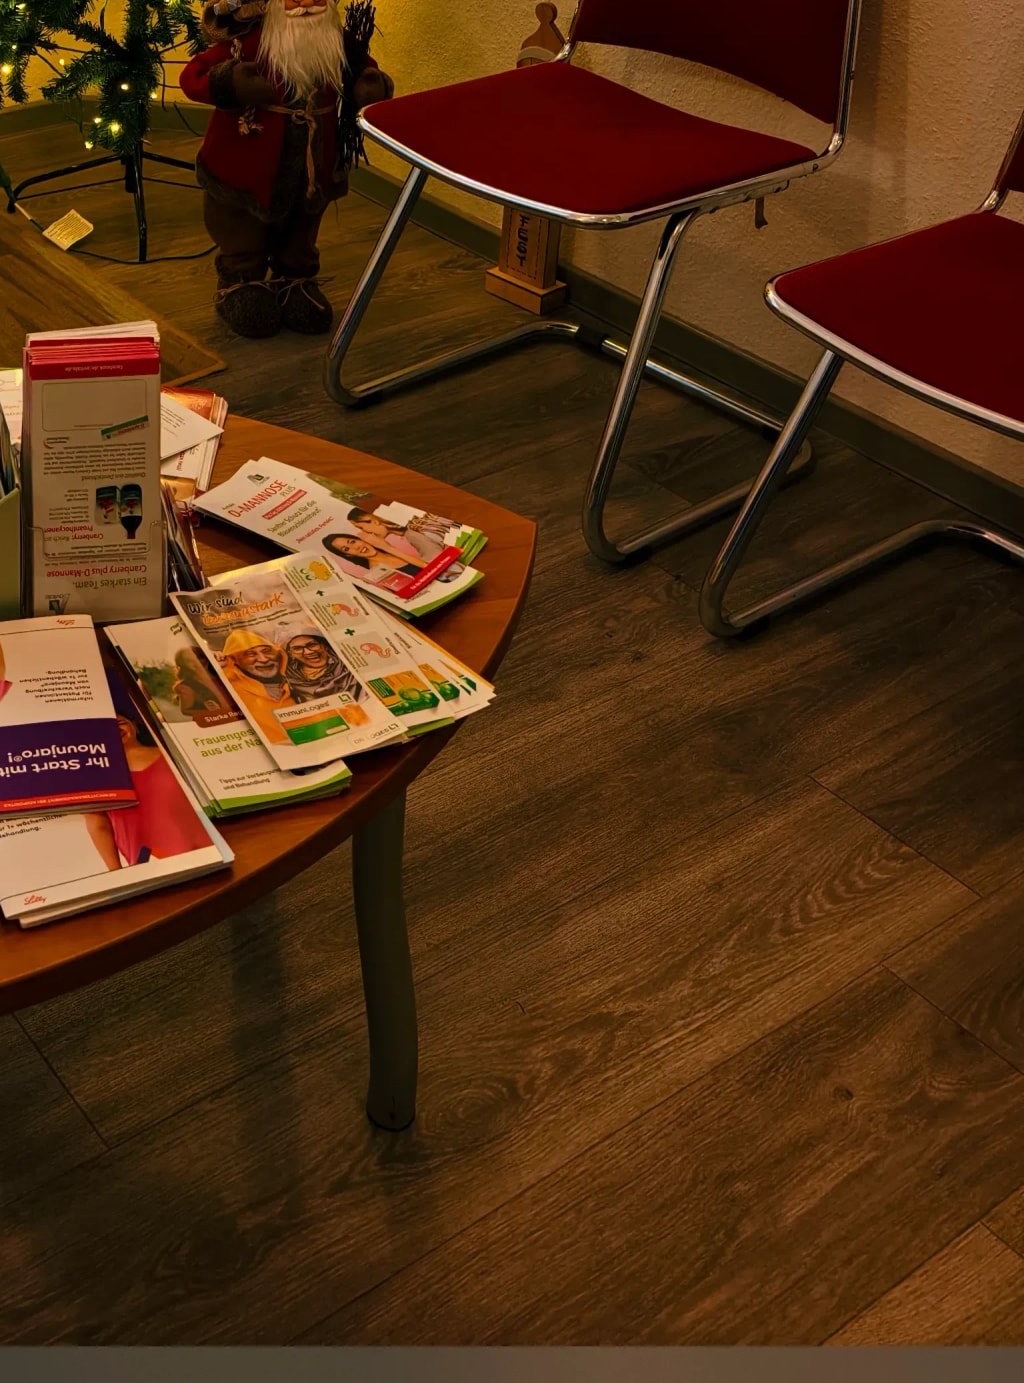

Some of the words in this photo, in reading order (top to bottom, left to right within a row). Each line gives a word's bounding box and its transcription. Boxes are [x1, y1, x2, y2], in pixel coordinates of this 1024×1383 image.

[227, 478, 288, 517] D-MANNOSE
[71, 532, 103, 540] Cranberry:
[46, 567, 89, 578] D-Mannose
[91, 565, 107, 575] plus
[109, 564, 146, 574] Cranberry
[72, 580, 98, 590] Team.
[100, 578, 131, 586] starkes
[133, 576, 147, 586] Ein
[187, 600, 212, 615] Wir
[213, 591, 244, 608] sind
[200, 747, 222, 757] aus
[223, 741, 243, 752] der
[31, 758, 80, 773] Start
[84, 756, 109, 769] Ihr
